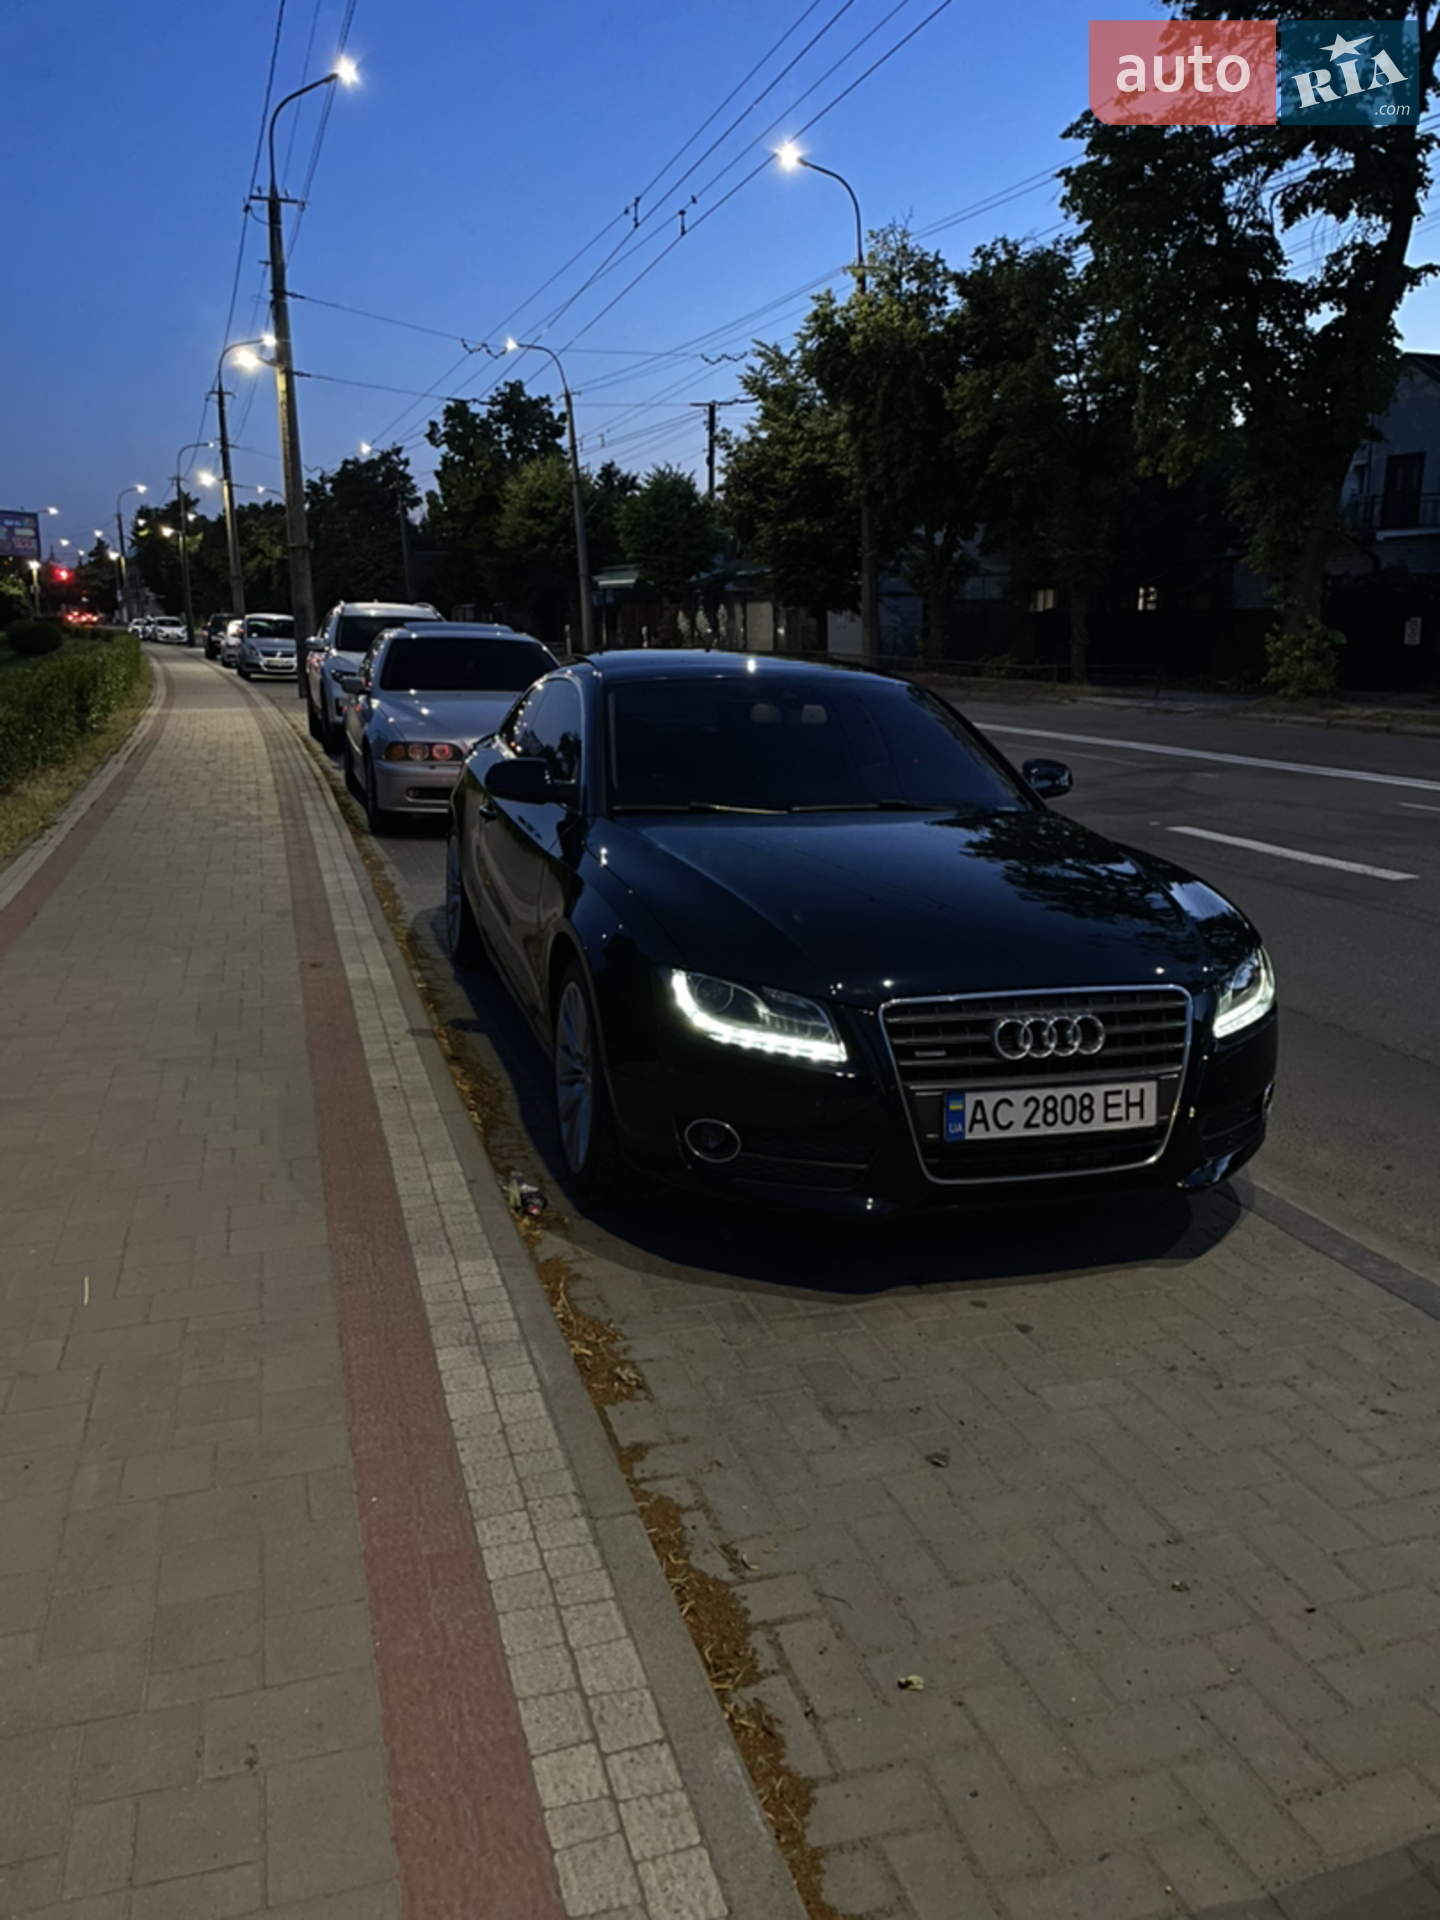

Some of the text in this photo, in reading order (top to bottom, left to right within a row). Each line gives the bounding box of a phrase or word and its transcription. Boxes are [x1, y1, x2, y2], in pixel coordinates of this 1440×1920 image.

[968, 1088, 1145, 1133] AC 2808 EH
[949, 1122, 964, 1134] UA
